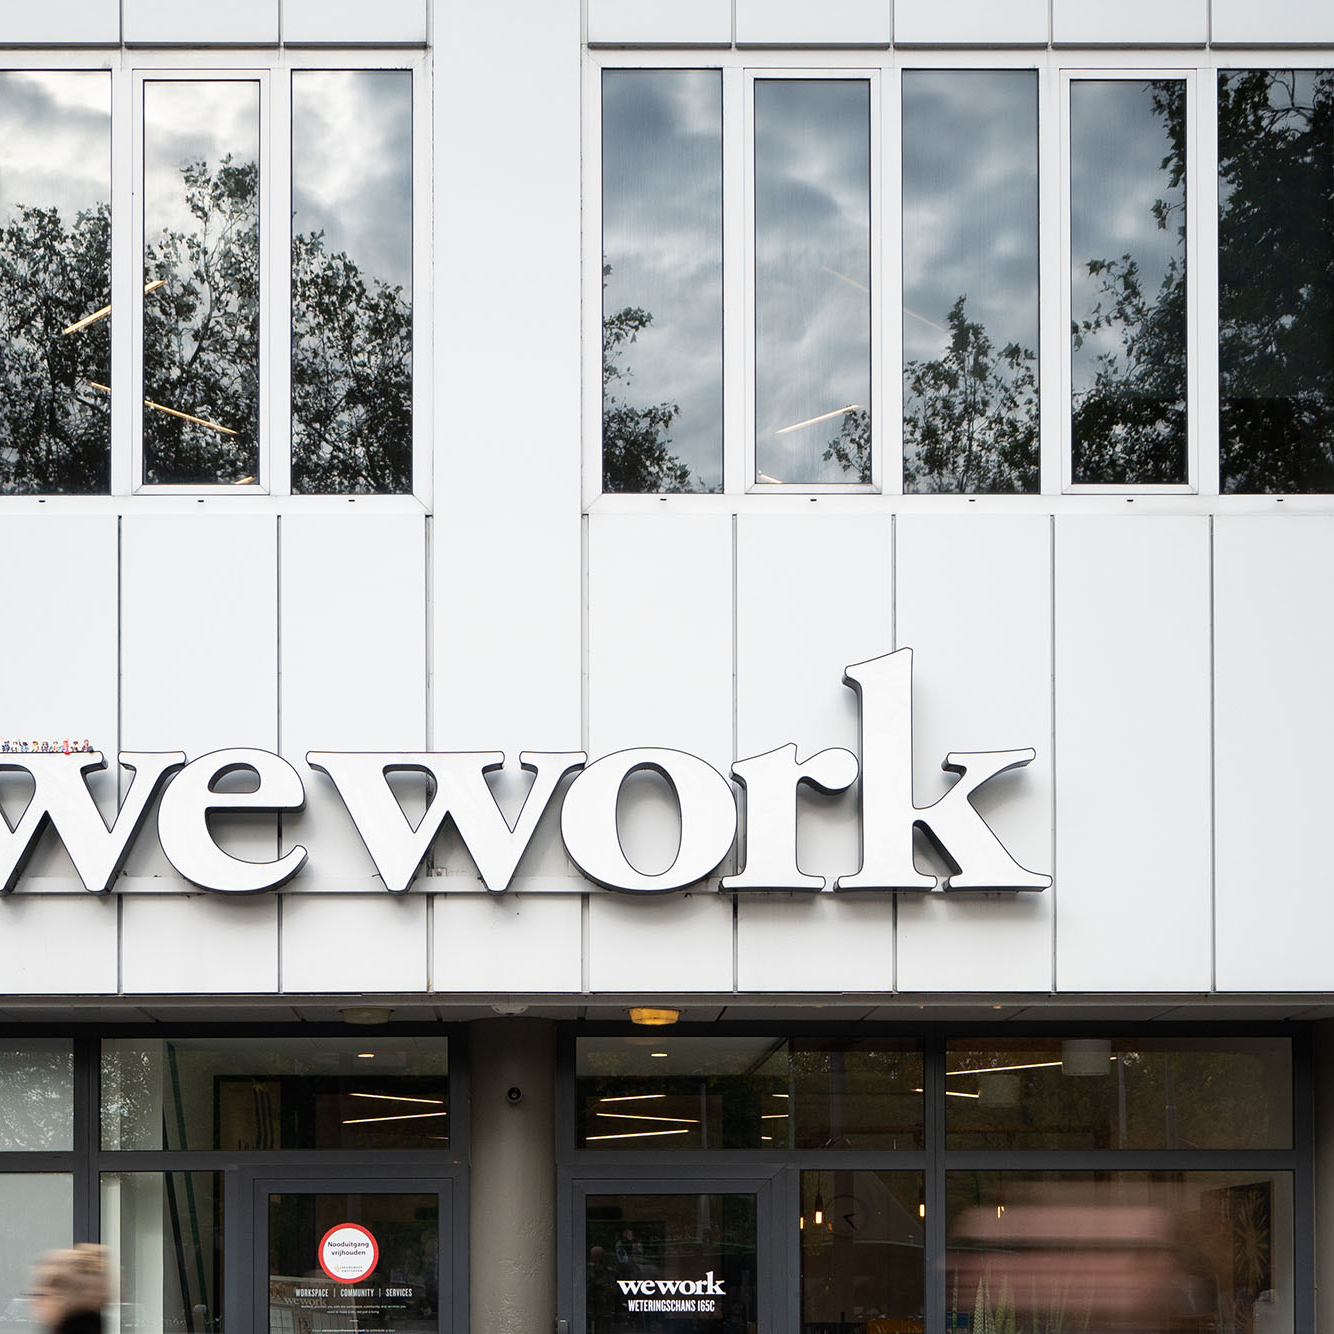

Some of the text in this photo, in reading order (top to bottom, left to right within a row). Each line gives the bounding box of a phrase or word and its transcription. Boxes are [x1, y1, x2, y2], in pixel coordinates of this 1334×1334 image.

[616, 1271, 727, 1295] wework
[295, 1288, 413, 1298] WORKSPACE COMMUNITY SERVICES
[628, 1300, 715, 1312] WETERINGSCHANS 165C
